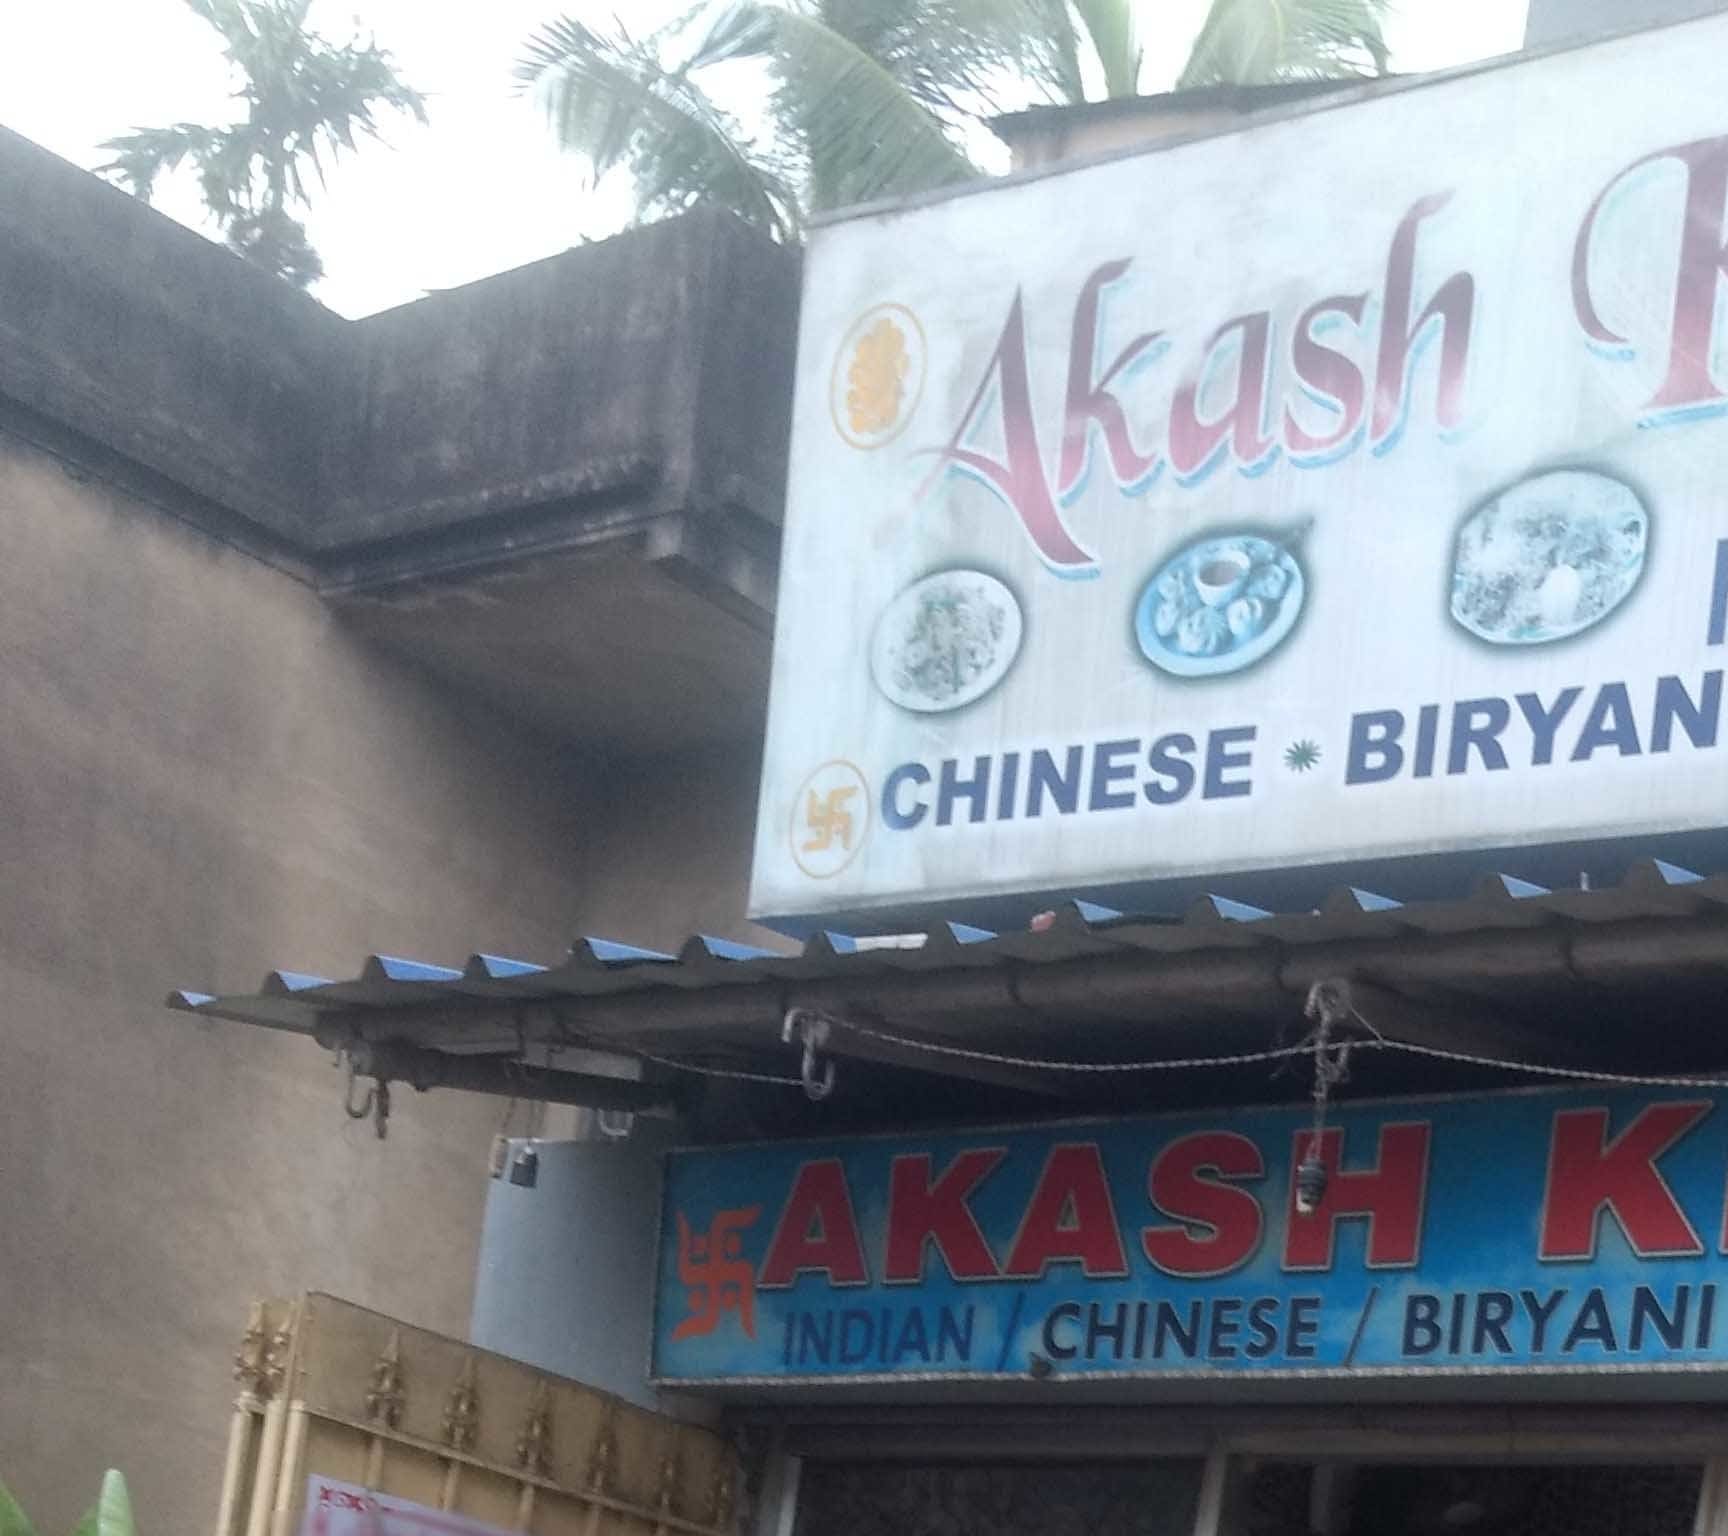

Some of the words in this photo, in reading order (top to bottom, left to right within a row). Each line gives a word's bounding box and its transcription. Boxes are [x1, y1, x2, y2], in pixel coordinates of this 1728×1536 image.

[910, 190, 1478, 578] Akash
[881, 724, 1258, 832] CHINESE
[757, 1120, 1430, 1290] AKASH
[781, 1304, 976, 1368] INDIAN
[1041, 1286, 1322, 1363] CHINESE
[1402, 1282, 1718, 1359] BIRYANI
